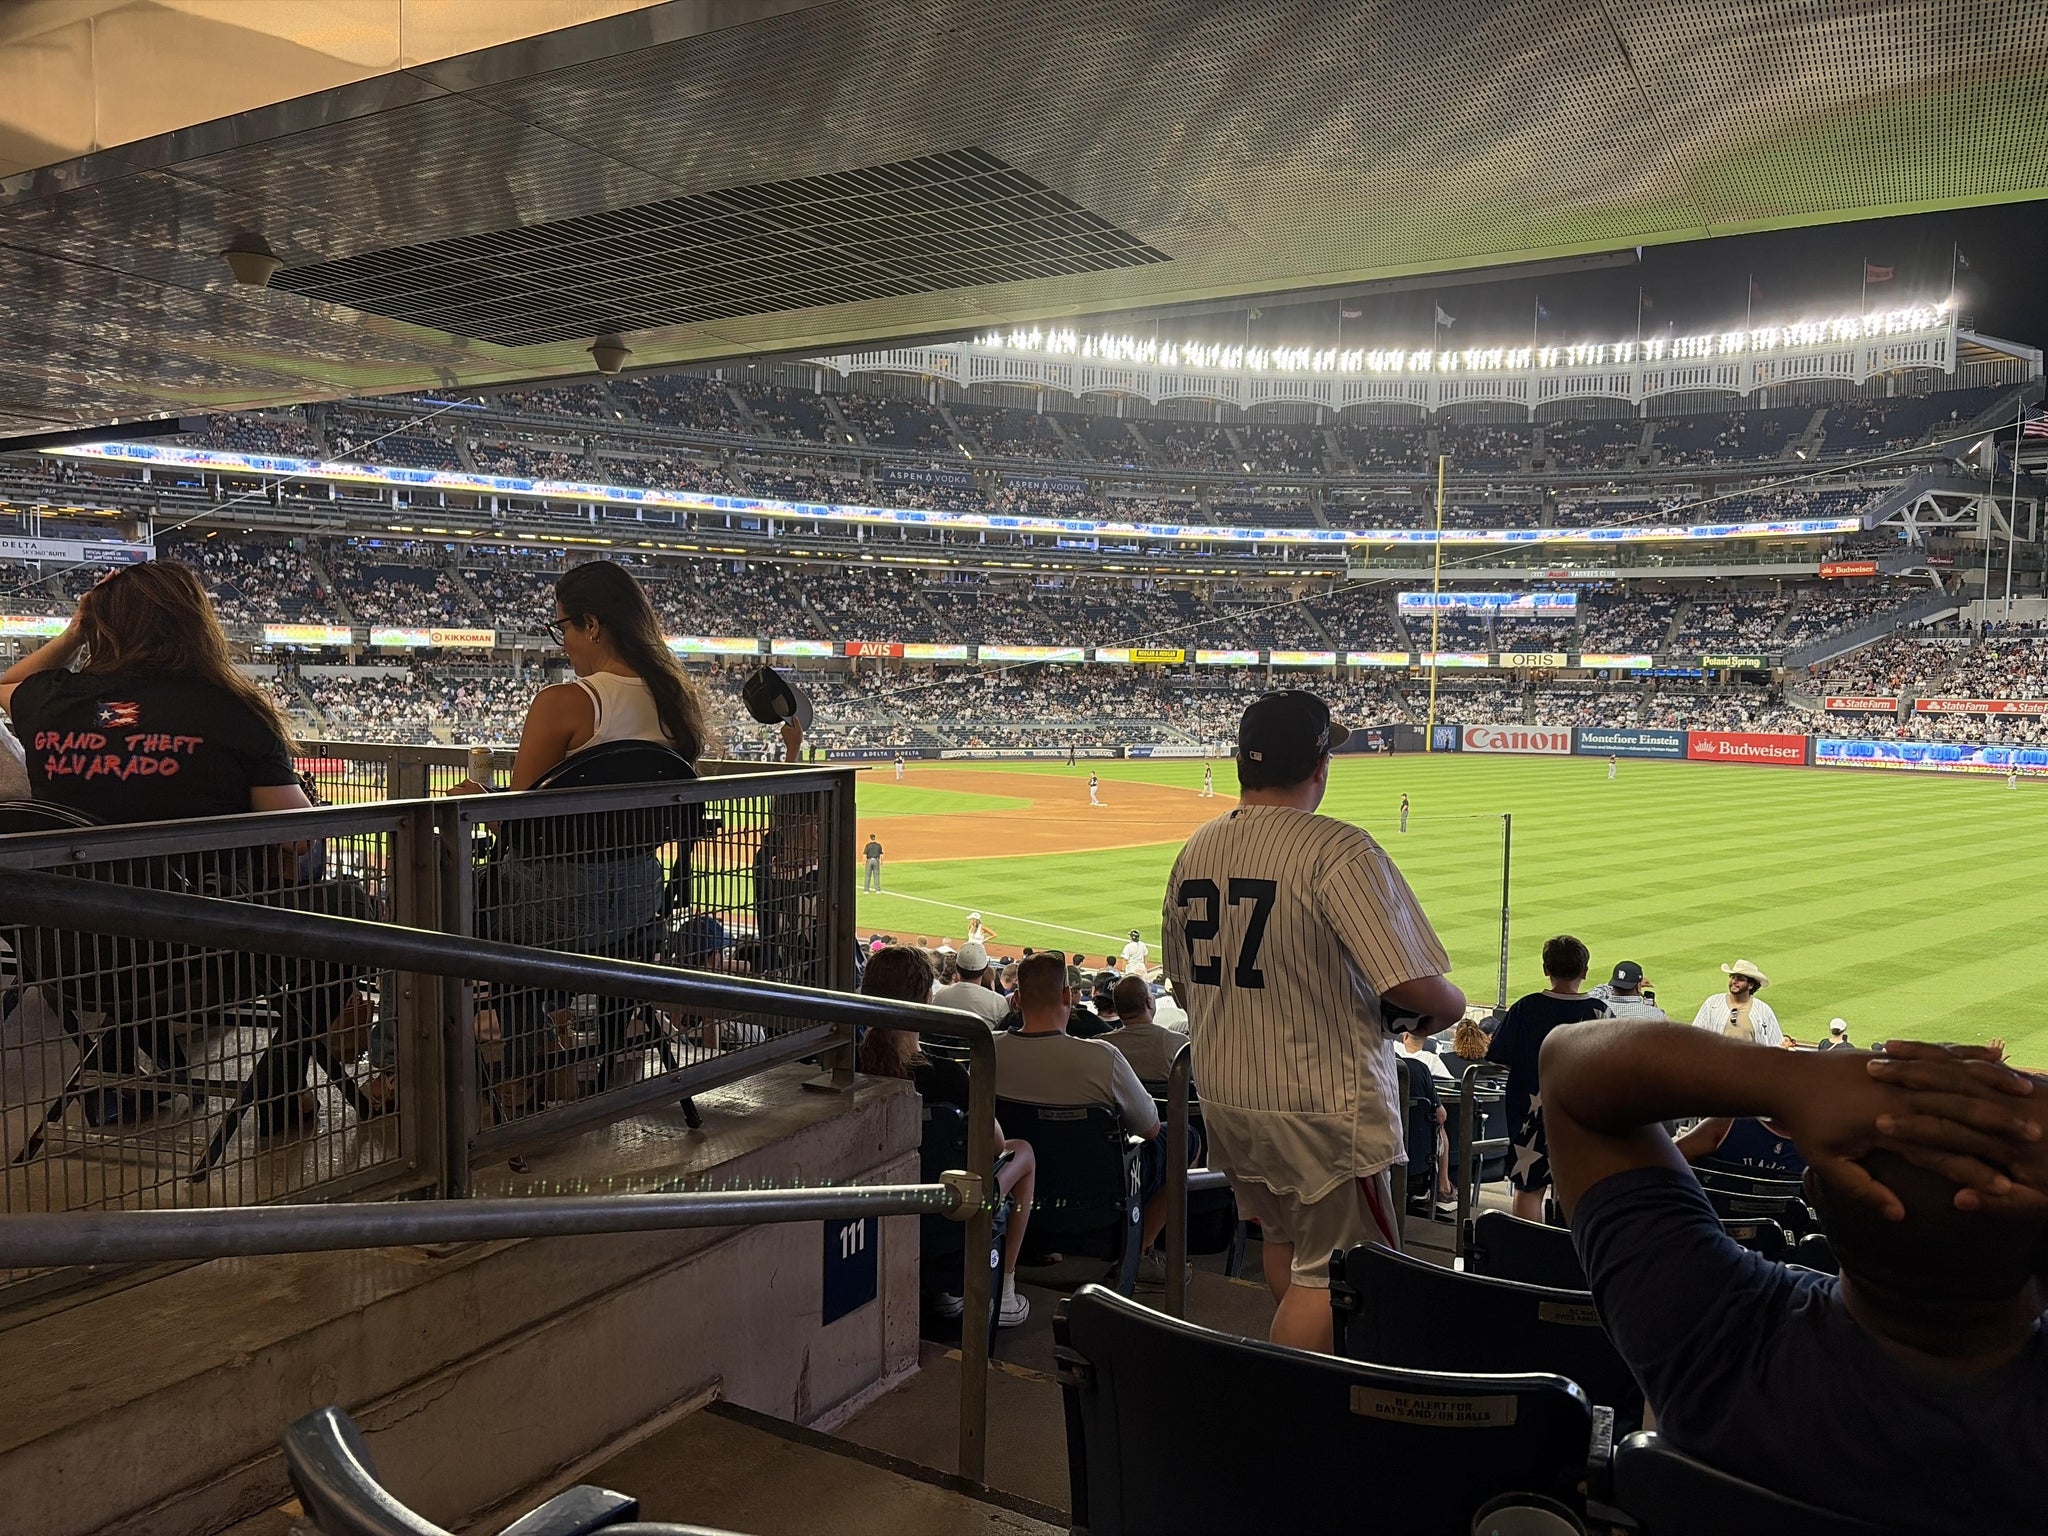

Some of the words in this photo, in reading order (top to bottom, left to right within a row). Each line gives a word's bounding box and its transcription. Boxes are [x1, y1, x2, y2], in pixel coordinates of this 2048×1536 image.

[889, 471, 923, 481] ASPEN
[935, 474, 967, 484] VODKA
[1008, 480, 1040, 489] ASPEN
[1051, 483, 1081, 492] VODKA
[2, 541, 38, 549] DELTA
[1835, 565, 1874, 574] Budweiser
[444, 634, 491, 642] KIKKOMAN
[859, 643, 891, 656] AVIS
[1512, 653, 1554, 666] ORIS
[1703, 656, 1731, 667] Poland
[1731, 656, 1761, 668] Spring
[34, 731, 108, 754] GRAND
[124, 733, 204, 755] THEFT
[1464, 727, 1568, 751] Canon
[1581, 733, 1637, 744] Montefiore
[1639, 734, 1679, 746] Einstein
[321, 745, 327, 756] 3
[1718, 741, 1800, 758] Budweiser
[45, 753, 180, 781] ALVARADO
[1177, 877, 1277, 989] 27
[840, 1217, 865, 1259] 111
[1395, 1398, 1409, 1407] BE
[1413, 1400, 1448, 1410] ALERT
[1451, 1403, 1472, 1412] FOR
[1376, 1403, 1404, 1415] BATS
[1407, 1408, 1453, 1421] AND/OR
[1456, 1411, 1491, 1421] BALLS
